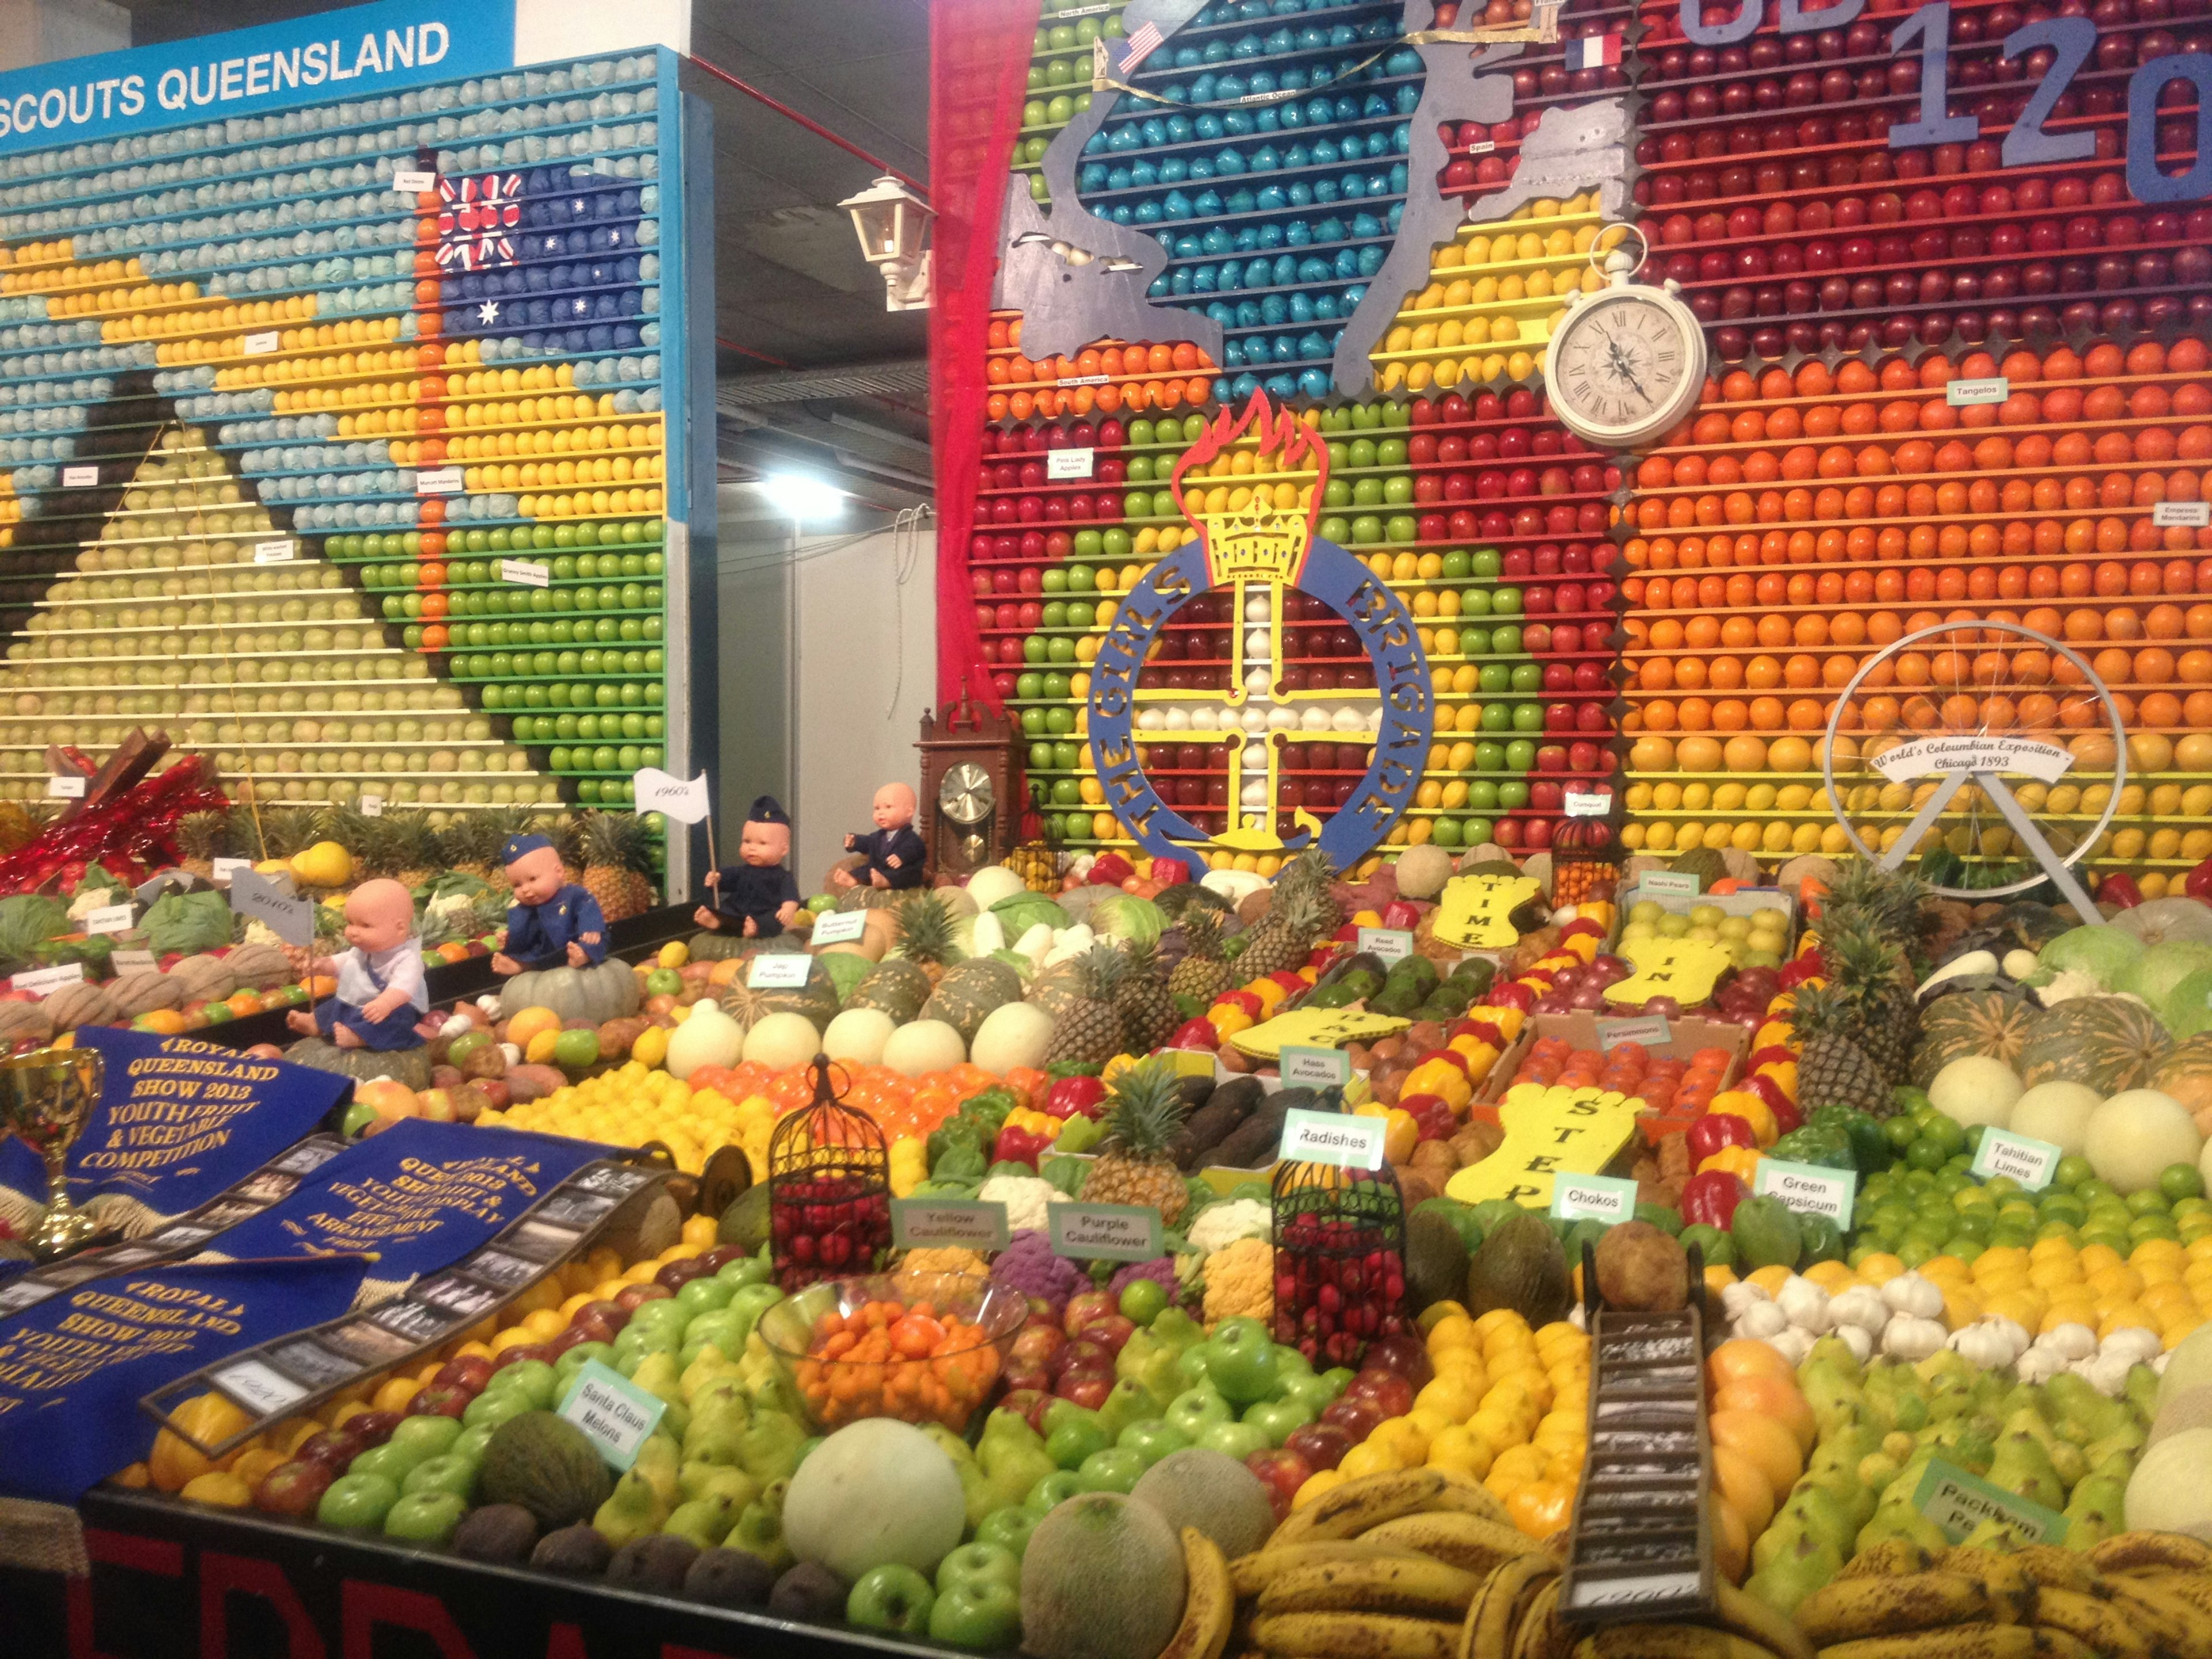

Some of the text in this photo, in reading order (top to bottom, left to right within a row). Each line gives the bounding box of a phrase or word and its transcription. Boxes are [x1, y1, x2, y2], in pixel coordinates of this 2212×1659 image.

[1060, 5, 1109, 17] North America
[158, 22, 450, 110] QUEENSLAND
[1241, 90, 1296, 103] Atlantic Ocean
[1471, 142, 1494, 152] Spain
[1058, 375, 1108, 386] South America
[1956, 385, 1997, 397] Tangelos
[1056, 457, 1086, 465] Pink Lady
[1060, 464, 1081, 472] Apples
[1095, 566, 1425, 838] THE GIRLS BRIGADE
[1998, 740, 2061, 757] Exposition
[1980, 756, 2010, 767] 1893
[821, 927, 854, 936] Pumpkin
[1368, 945, 1402, 953] Avocados
[759, 971, 796, 979] Pumpkin
[1607, 1026, 1660, 1039] Persimmons
[173, 1039, 252, 1059] ROYAL
[127, 1058, 280, 1081] QUEENSLAND
[1303, 1058, 1325, 1068] Hass
[1293, 1067, 1336, 1080] Avocados
[131, 1079, 253, 1101] SHOW 2013
[107, 1101, 190, 1126] YOUTH
[105, 1115, 233, 1149] & VEGETABLE
[1300, 1129, 1368, 1149] Radishes
[78, 1128, 232, 1169] COMPETITION
[1994, 1143, 2044, 1168] Tahitian
[1994, 1158, 2032, 1180] Limes
[1783, 1177, 1827, 1194] Green
[1569, 1189, 1619, 1208] Chokos
[926, 1212, 975, 1224] Yellow
[1081, 1216, 1129, 1230] Purple
[910, 1226, 993, 1240] Cauliflower
[1066, 1230, 1148, 1248] Cauliflower
[582, 1383, 647, 1432] Santa Claus
[582, 1409, 622, 1444] Melons
[1940, 1483, 2037, 1540] Packham
